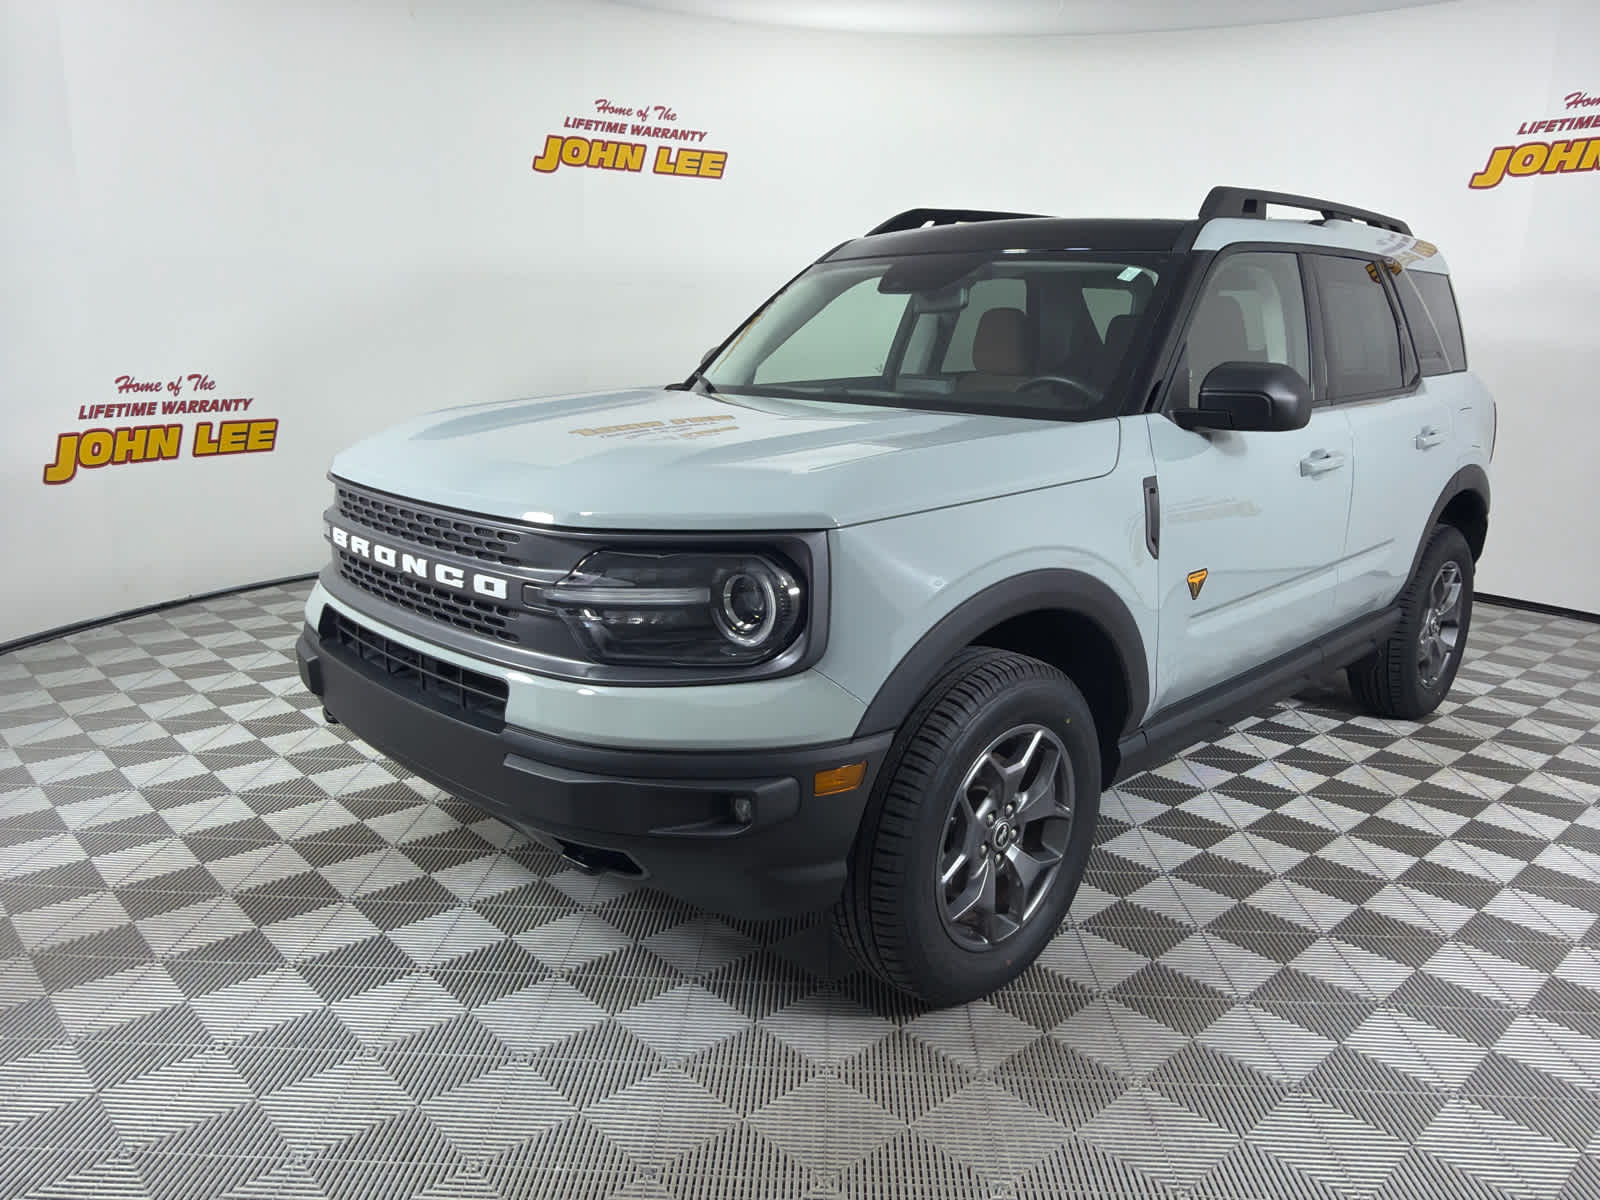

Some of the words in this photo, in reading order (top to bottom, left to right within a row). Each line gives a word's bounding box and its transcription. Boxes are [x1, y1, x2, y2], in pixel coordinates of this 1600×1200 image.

[594, 98, 633, 117] Home
[636, 106, 651, 122] of
[653, 106, 677, 121] The
[563, 116, 628, 135] LIFETIME
[630, 125, 708, 142] WARRANTY
[532, 134, 647, 174] JOHN
[652, 145, 728, 179] LEE
[114, 374, 163, 394] Home
[167, 376, 183, 397] of
[187, 373, 216, 392] The
[78, 401, 157, 420] LIFETIME
[161, 398, 254, 415] WARRANTY
[43, 423, 183, 485] JOHN
[192, 418, 279, 458] LEE
[331, 525, 508, 600] BRONCO
